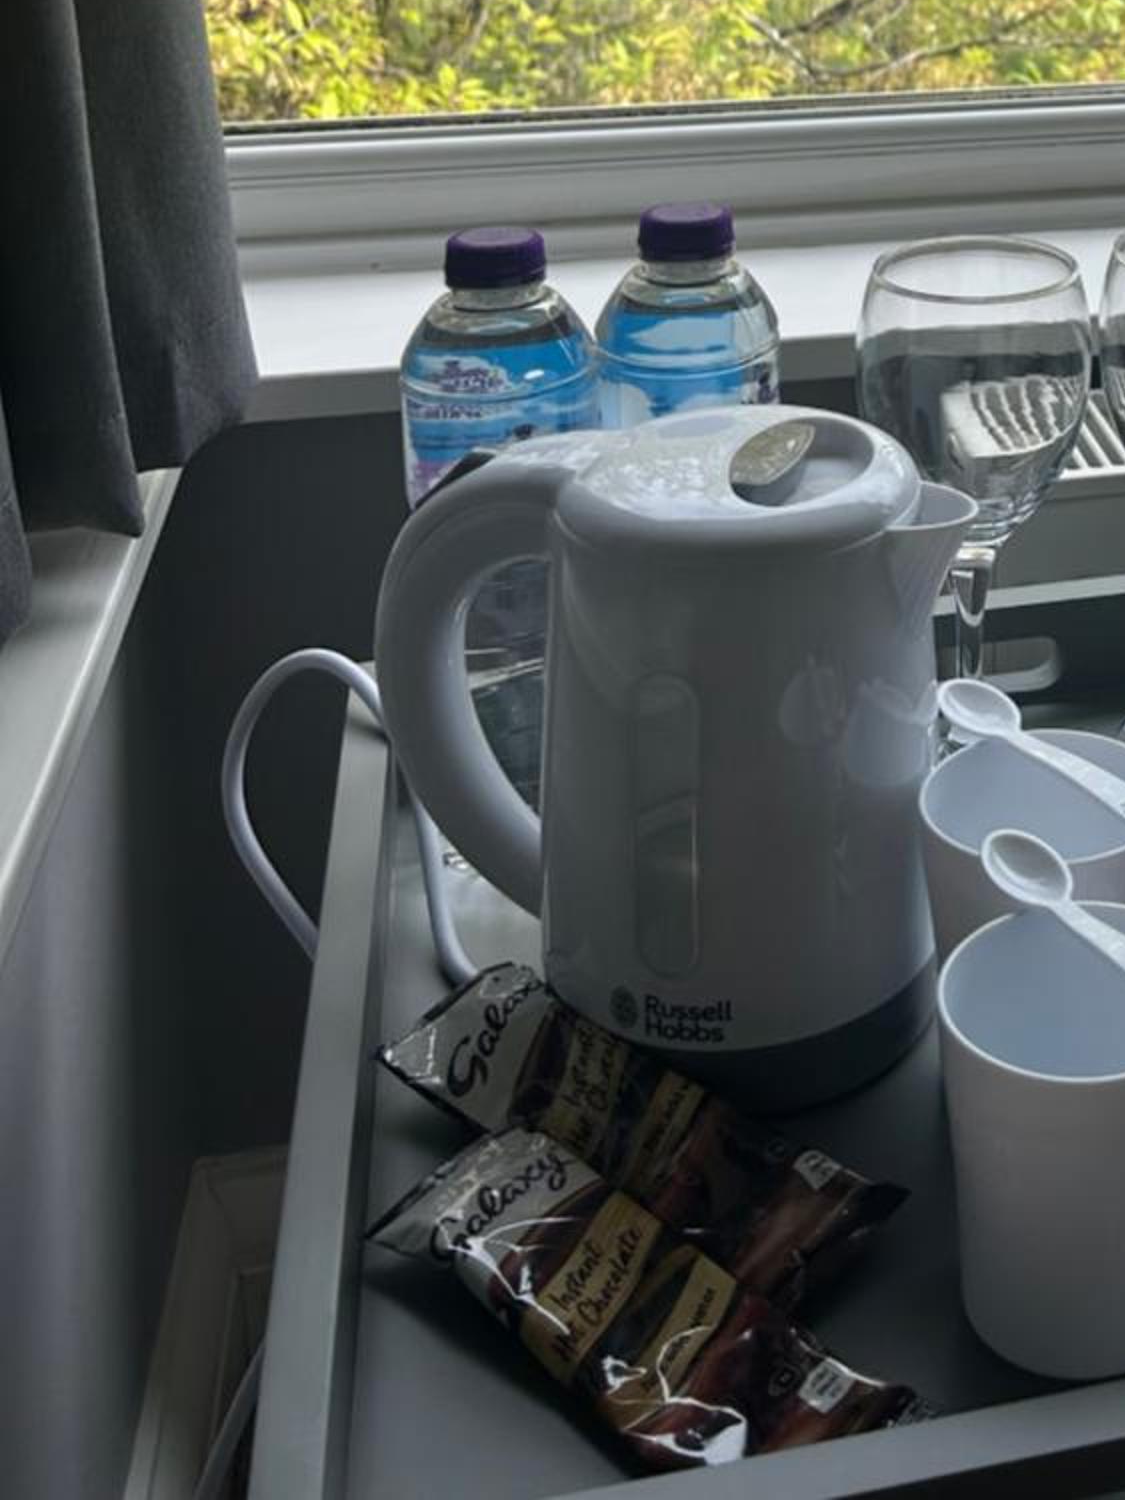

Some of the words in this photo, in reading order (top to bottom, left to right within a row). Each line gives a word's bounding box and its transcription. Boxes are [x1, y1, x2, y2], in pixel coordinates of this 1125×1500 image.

[447, 978, 546, 1098] Galax
[644, 994, 732, 1021] Russell
[644, 1016, 725, 1042] Hobbs
[430, 1153, 570, 1262] Galaxy
[550, 1241, 602, 1314] Instant
